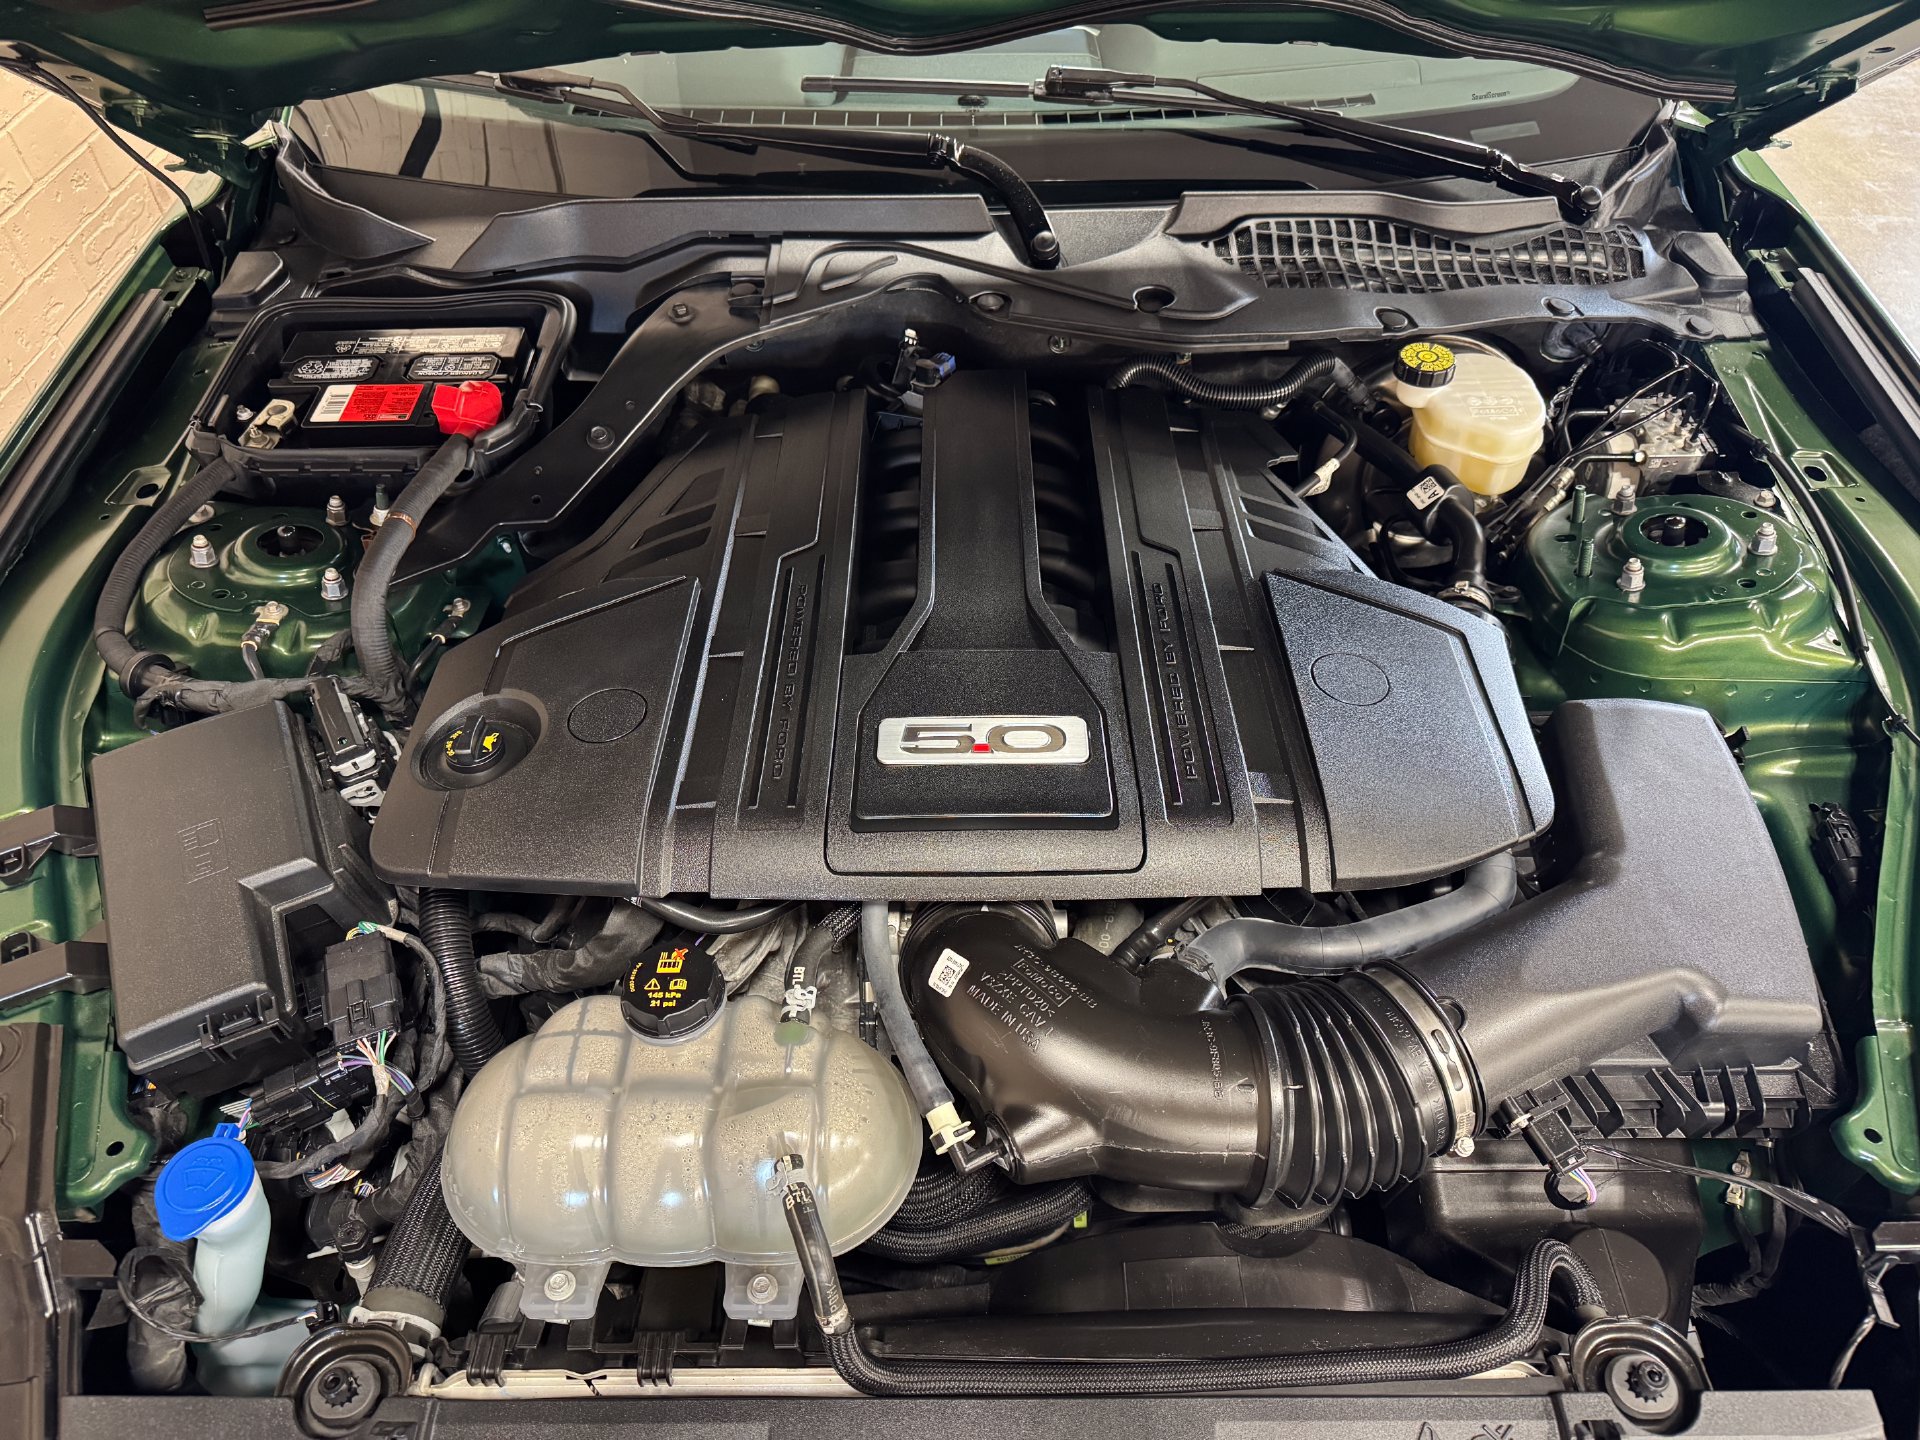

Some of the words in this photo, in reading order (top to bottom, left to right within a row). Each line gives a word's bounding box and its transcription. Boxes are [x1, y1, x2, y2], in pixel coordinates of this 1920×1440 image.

[787, 584, 807, 675] POWERED
[1152, 583, 1170, 632] FORD
[1162, 637, 1177, 664] BY
[782, 684, 794, 710] BY
[900, 723, 1067, 754] 5.0
[1169, 672, 1198, 779] POWERED
[772, 719, 790, 779] FORD
[1016, 960, 1065, 1002] FoMoCo
[662, 1000, 676, 1008] psi
[966, 984, 1004, 1016] MADE
[1000, 1010, 1018, 1027] IN
[1013, 1023, 1044, 1053] USA
